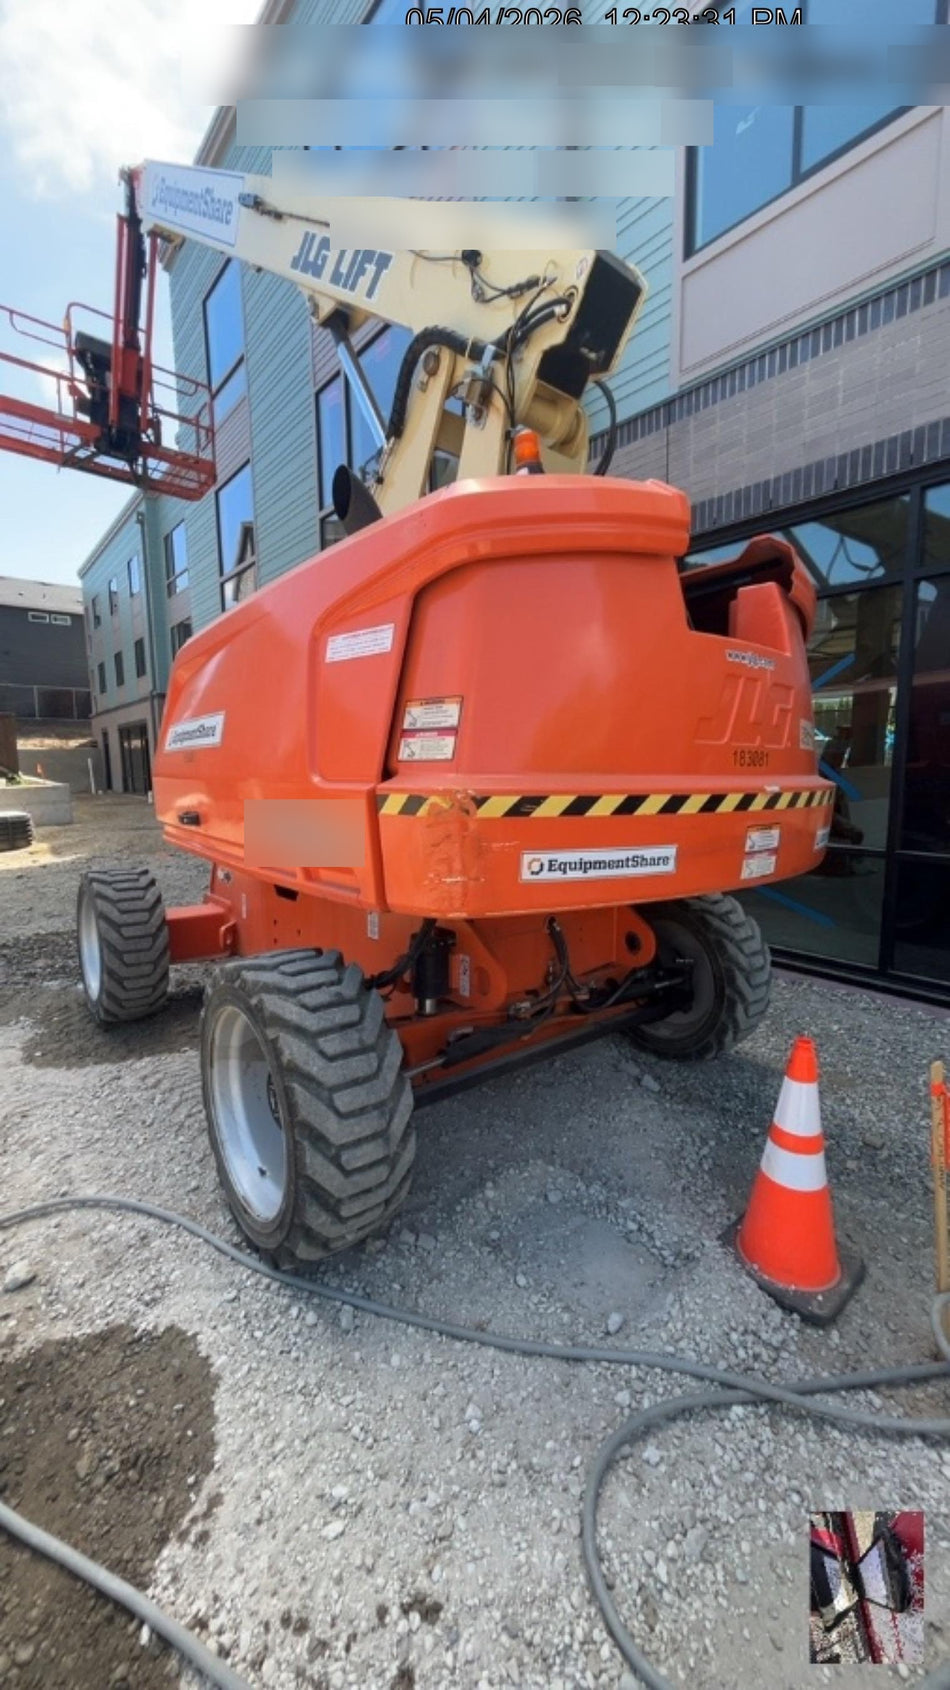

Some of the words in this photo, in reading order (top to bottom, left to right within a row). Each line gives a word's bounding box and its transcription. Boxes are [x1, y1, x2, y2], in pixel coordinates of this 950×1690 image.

[290, 231, 330, 279] JLG
[329, 250, 393, 300] LIFT
[546, 854, 671, 875] EquipmentShare
